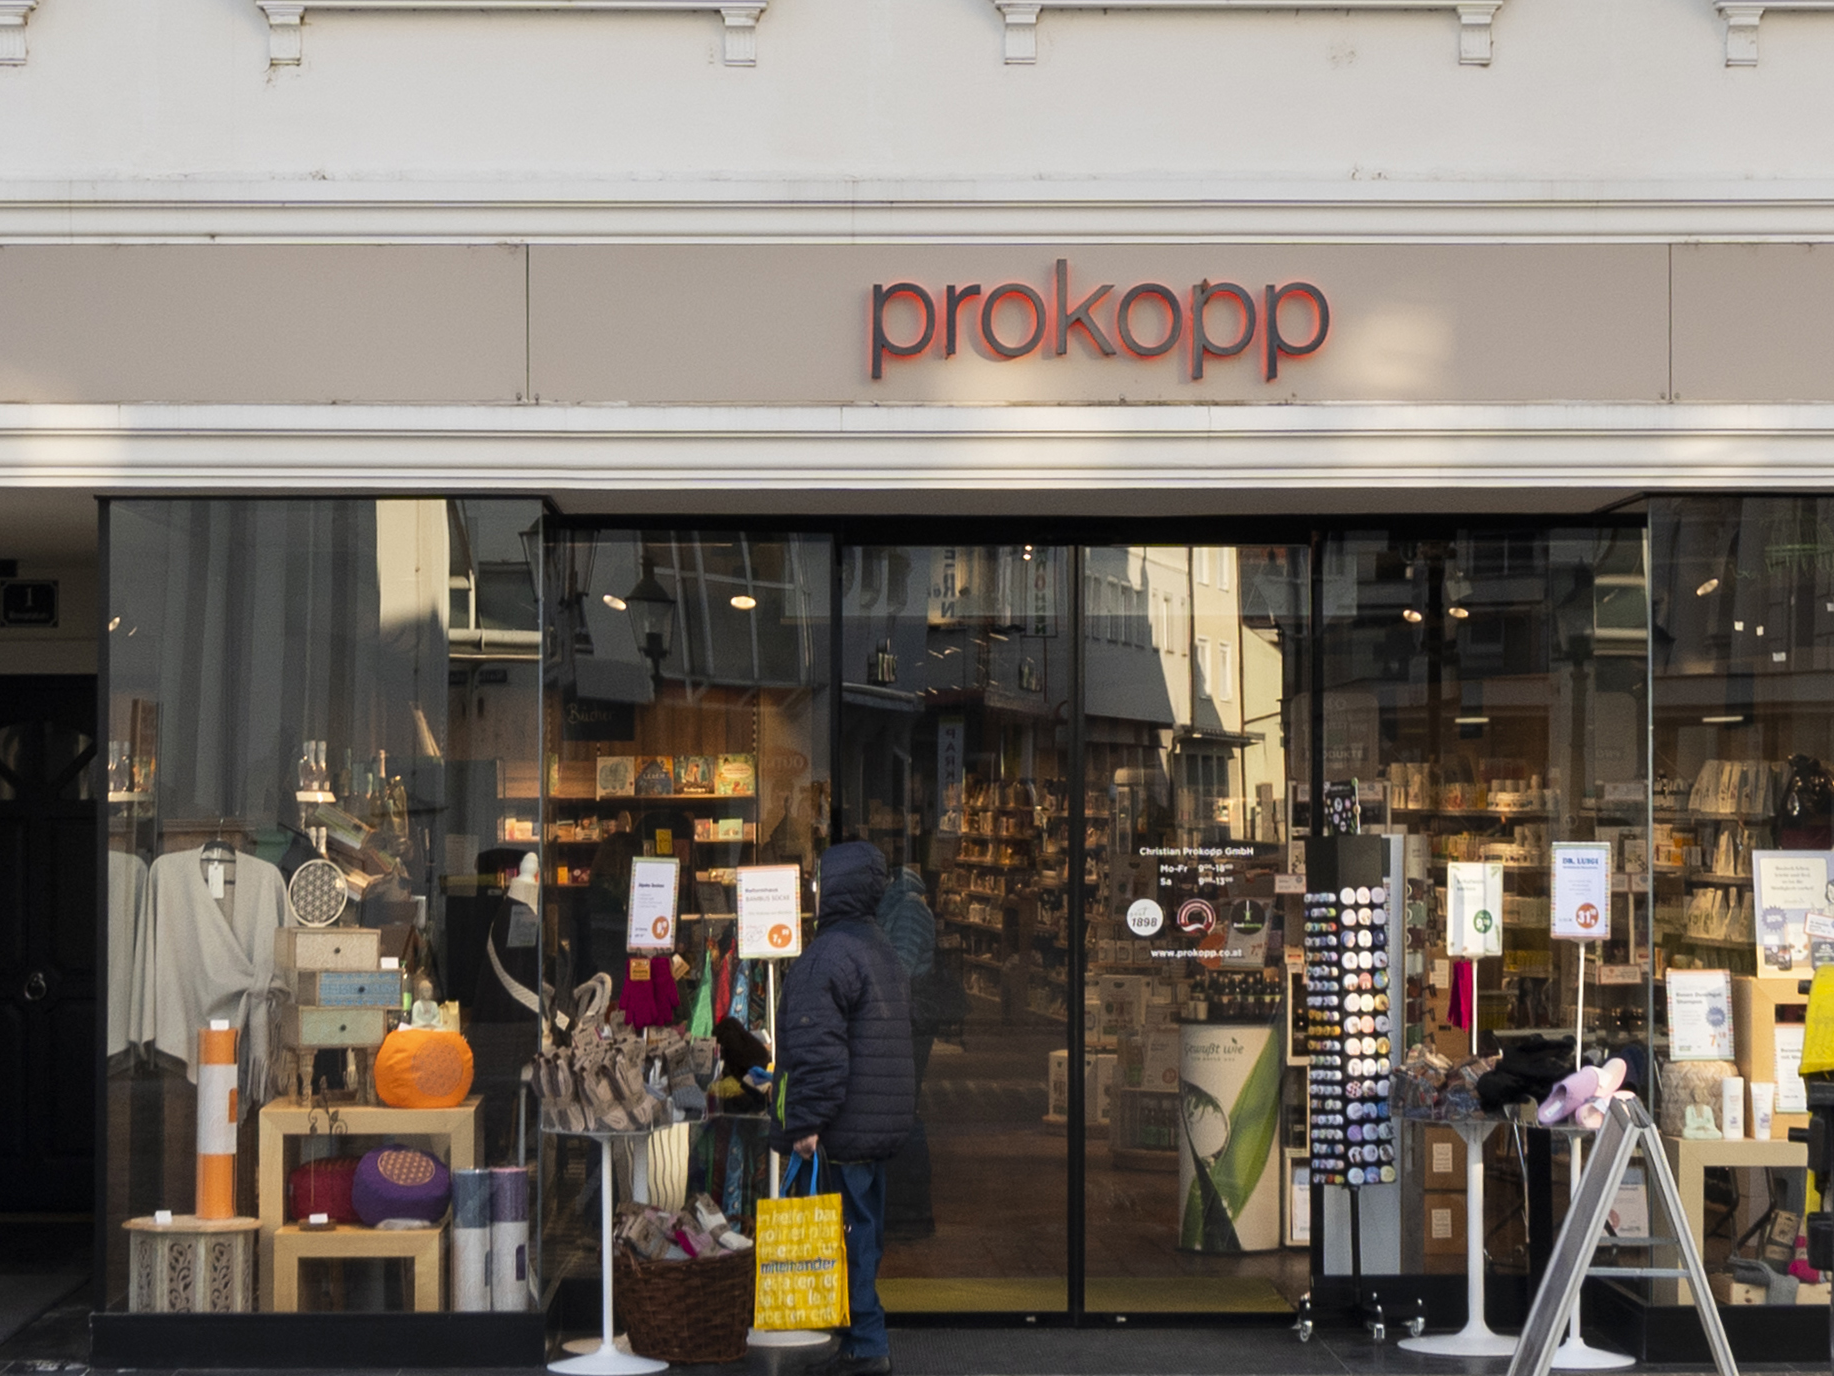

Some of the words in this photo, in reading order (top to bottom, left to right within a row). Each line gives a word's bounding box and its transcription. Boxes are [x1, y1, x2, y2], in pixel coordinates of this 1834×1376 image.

[871, 258, 1330, 381] prokopp
[1139, 847, 1181, 856] Christian
[1183, 847, 1223, 857] Prokopp
[1225, 847, 1254, 856] GmbH
[1160, 864, 1188, 873] Mo-Fr
[1160, 877, 1172, 886] Sa
[1131, 917, 1158, 928] 1898
[1150, 949, 1242, 959] www.prokopp.co.at
